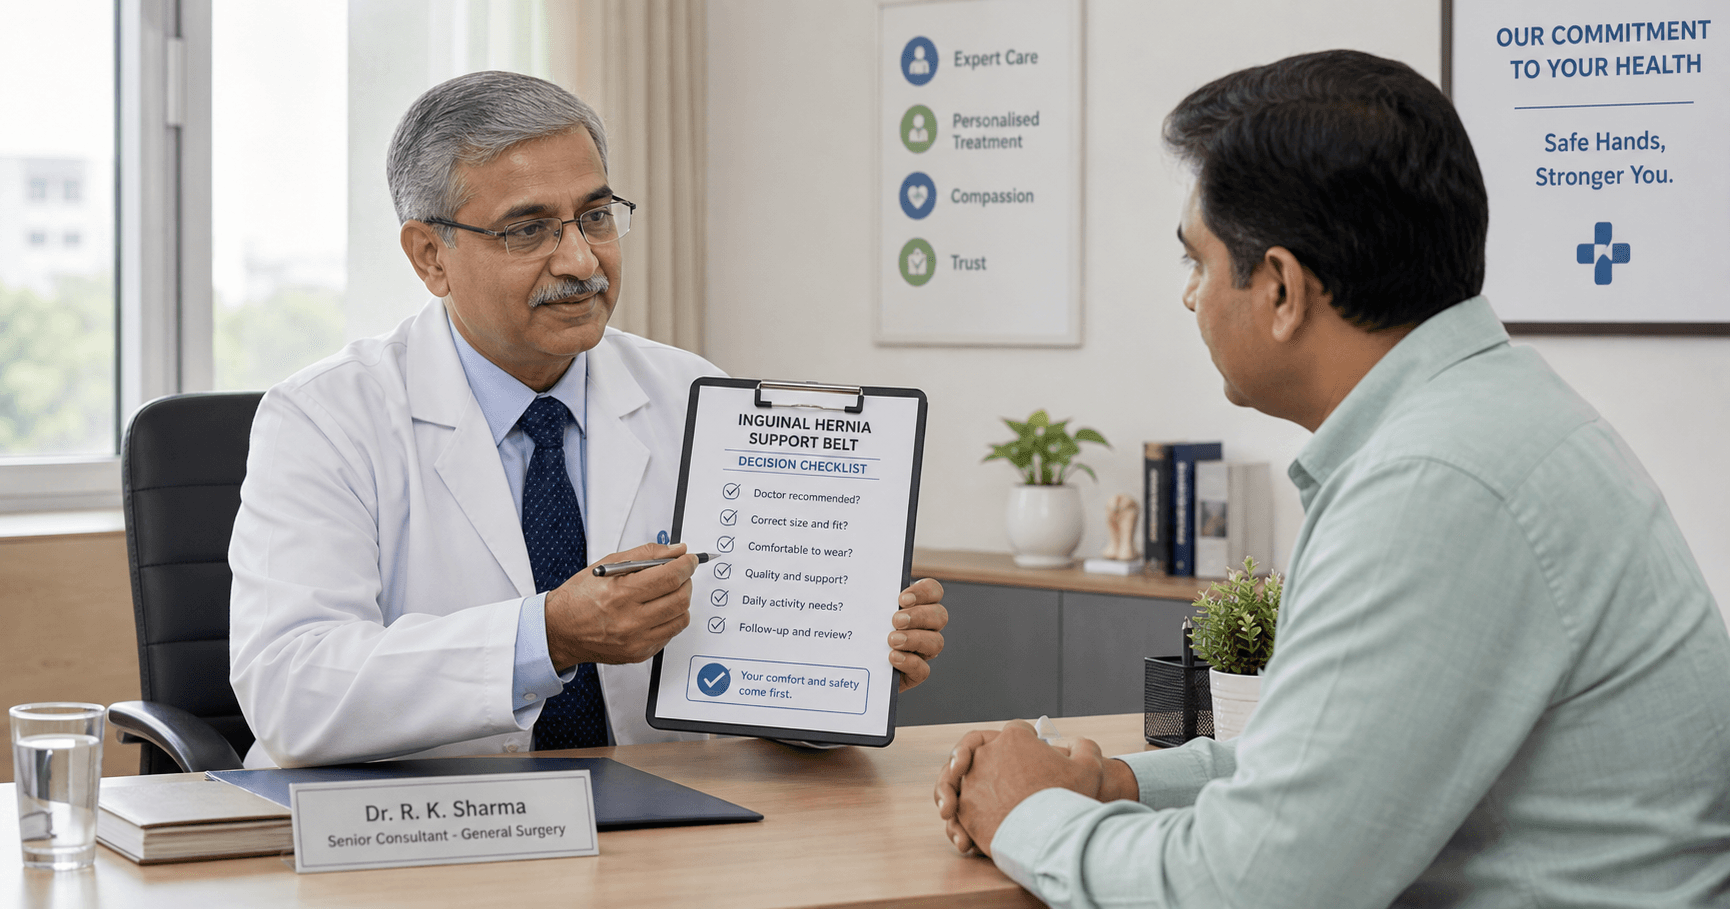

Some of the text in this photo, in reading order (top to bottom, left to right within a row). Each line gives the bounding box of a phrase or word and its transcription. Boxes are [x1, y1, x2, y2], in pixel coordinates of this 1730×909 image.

[1497, 20, 1711, 47] OUR COMMITMENT
[954, 49, 1038, 70] Expert Care
[1510, 54, 1701, 79] TO YOUR HEALTH
[953, 111, 1039, 128] Personalised
[953, 135, 1022, 149] Treatment
[1545, 131, 1665, 153] Safe Hands,
[1536, 165, 1673, 190] Stronger You.
[951, 188, 1034, 207] Compassion
[951, 255, 986, 270] Trust
[739, 414, 871, 433] INGUINAL HERNIA
[749, 433, 858, 451] SUPPORT BELT
[738, 456, 868, 474] DECISION CHECKLIST
[754, 489, 861, 504] Doctor recommended?
[750, 515, 849, 531] Correct size and fit?
[748, 542, 853, 558] Comfortable to wear?
[745, 569, 849, 586] Quality and support?
[742, 595, 844, 612] Daily activity needs?
[739, 623, 852, 639] Follow-up and review?
[741, 671, 859, 691] Your comfort and safety
[739, 688, 792, 698] come first.
[366, 800, 526, 822] Dr. R. K. Sharma
[328, 834, 371, 847] Senior
[376, 830, 448, 845] Consultant
[461, 826, 512, 840] General
[516, 825, 565, 838] Surgery
